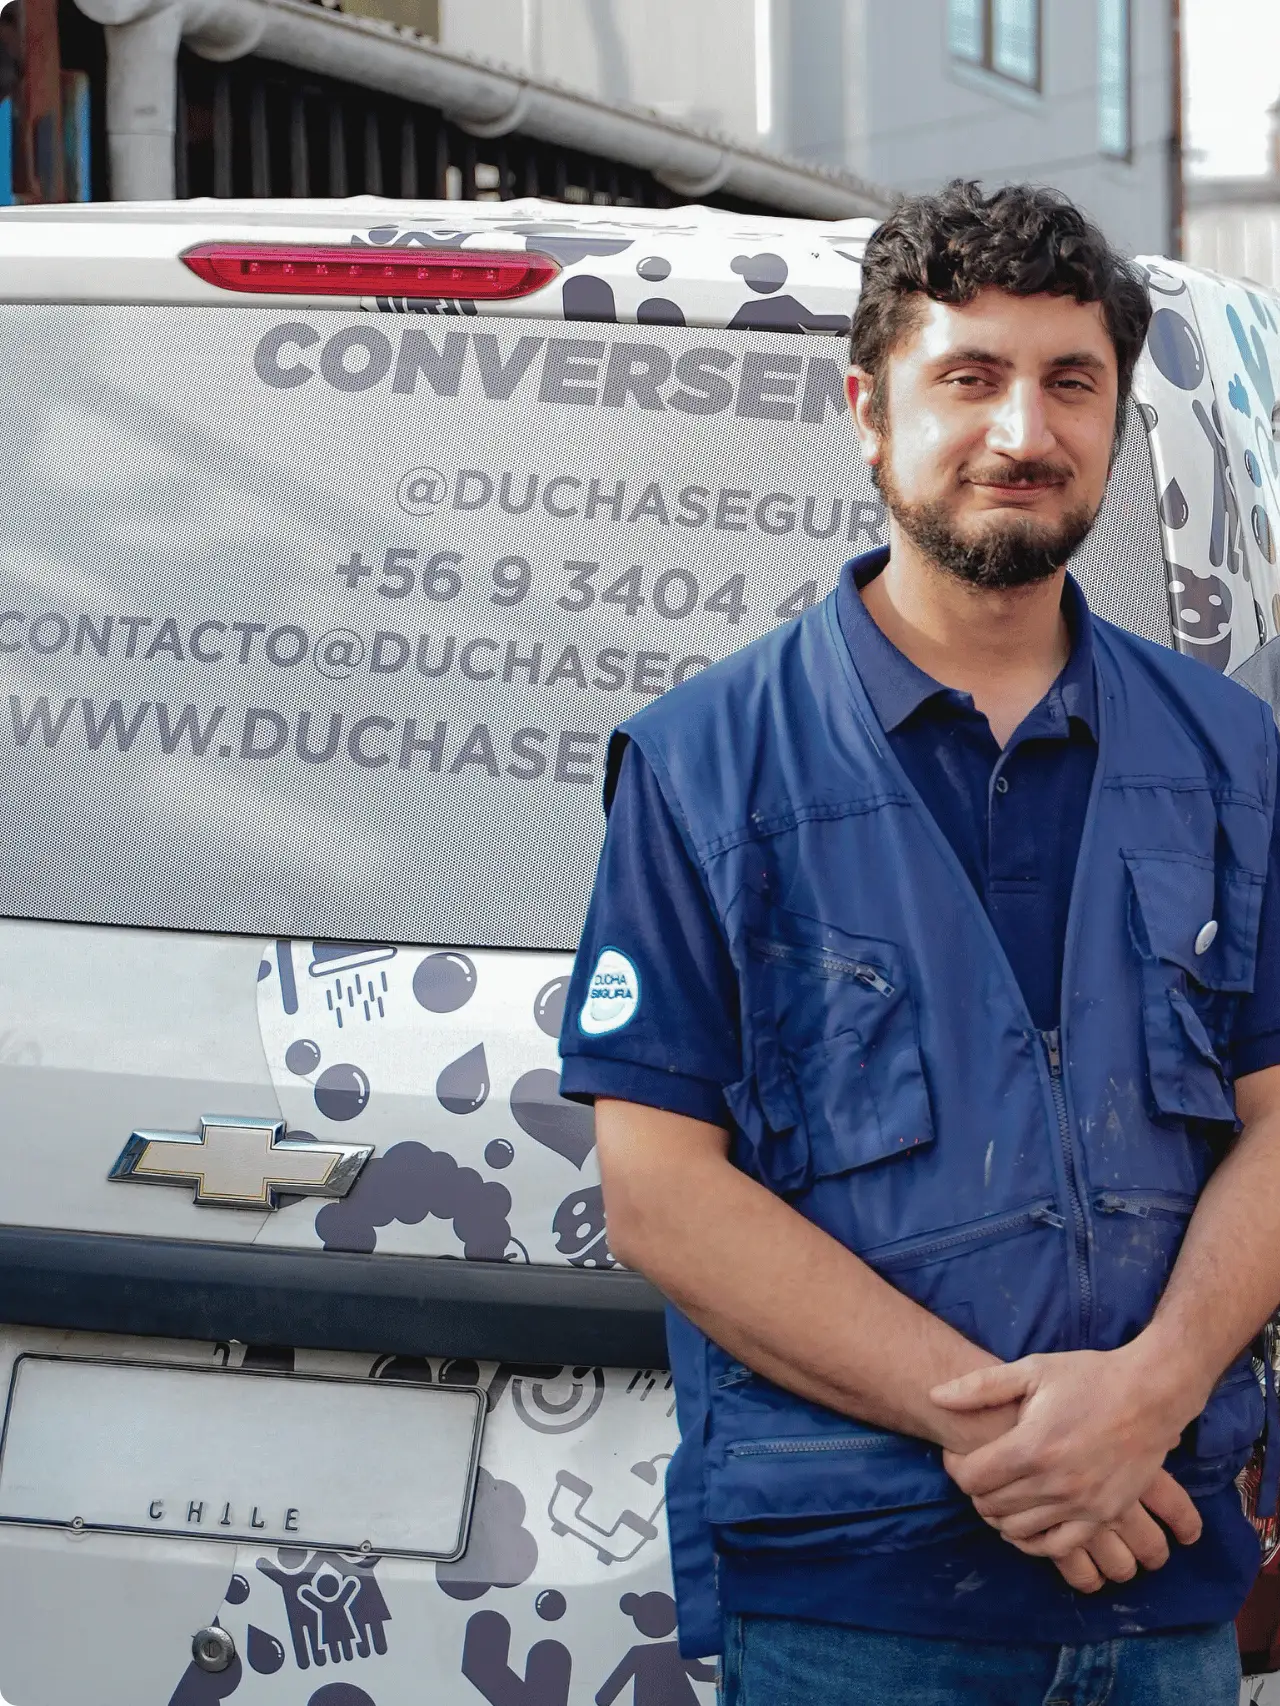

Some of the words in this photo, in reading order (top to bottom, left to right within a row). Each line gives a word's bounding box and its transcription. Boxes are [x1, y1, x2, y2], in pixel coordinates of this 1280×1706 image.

[335, 548, 463, 601] +56
[489, 555, 532, 607] 9
[556, 560, 748, 625] 3404
[8, 694, 600, 786] WWW.DUCHASE
[149, 1499, 300, 1532] CHILE
